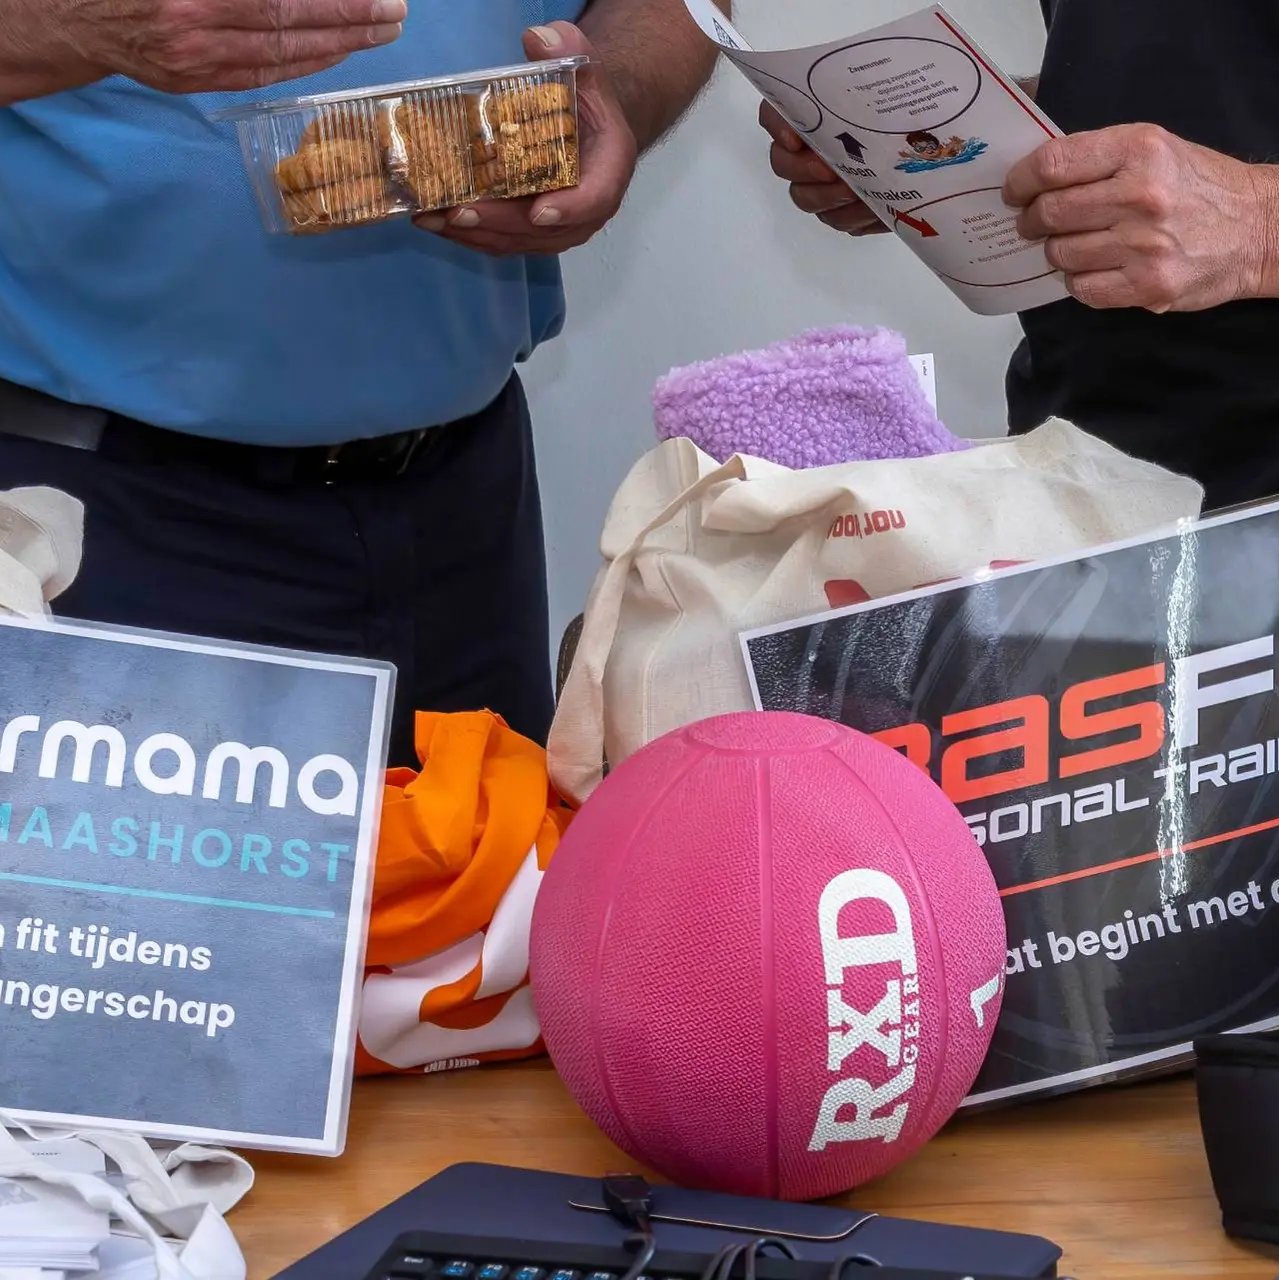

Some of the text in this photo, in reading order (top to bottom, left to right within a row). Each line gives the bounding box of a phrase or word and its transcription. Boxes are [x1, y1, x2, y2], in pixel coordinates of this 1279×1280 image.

[871, 189, 923, 202] maken
[863, 509, 907, 537] JOU
[15, 915, 59, 956] fit
[68, 923, 212, 972] tijdens
[1001, 930, 1039, 978] at
[1049, 902, 1182, 964] begint
[1189, 884, 1266, 926] met
[902, 973, 920, 1066] GEAR
